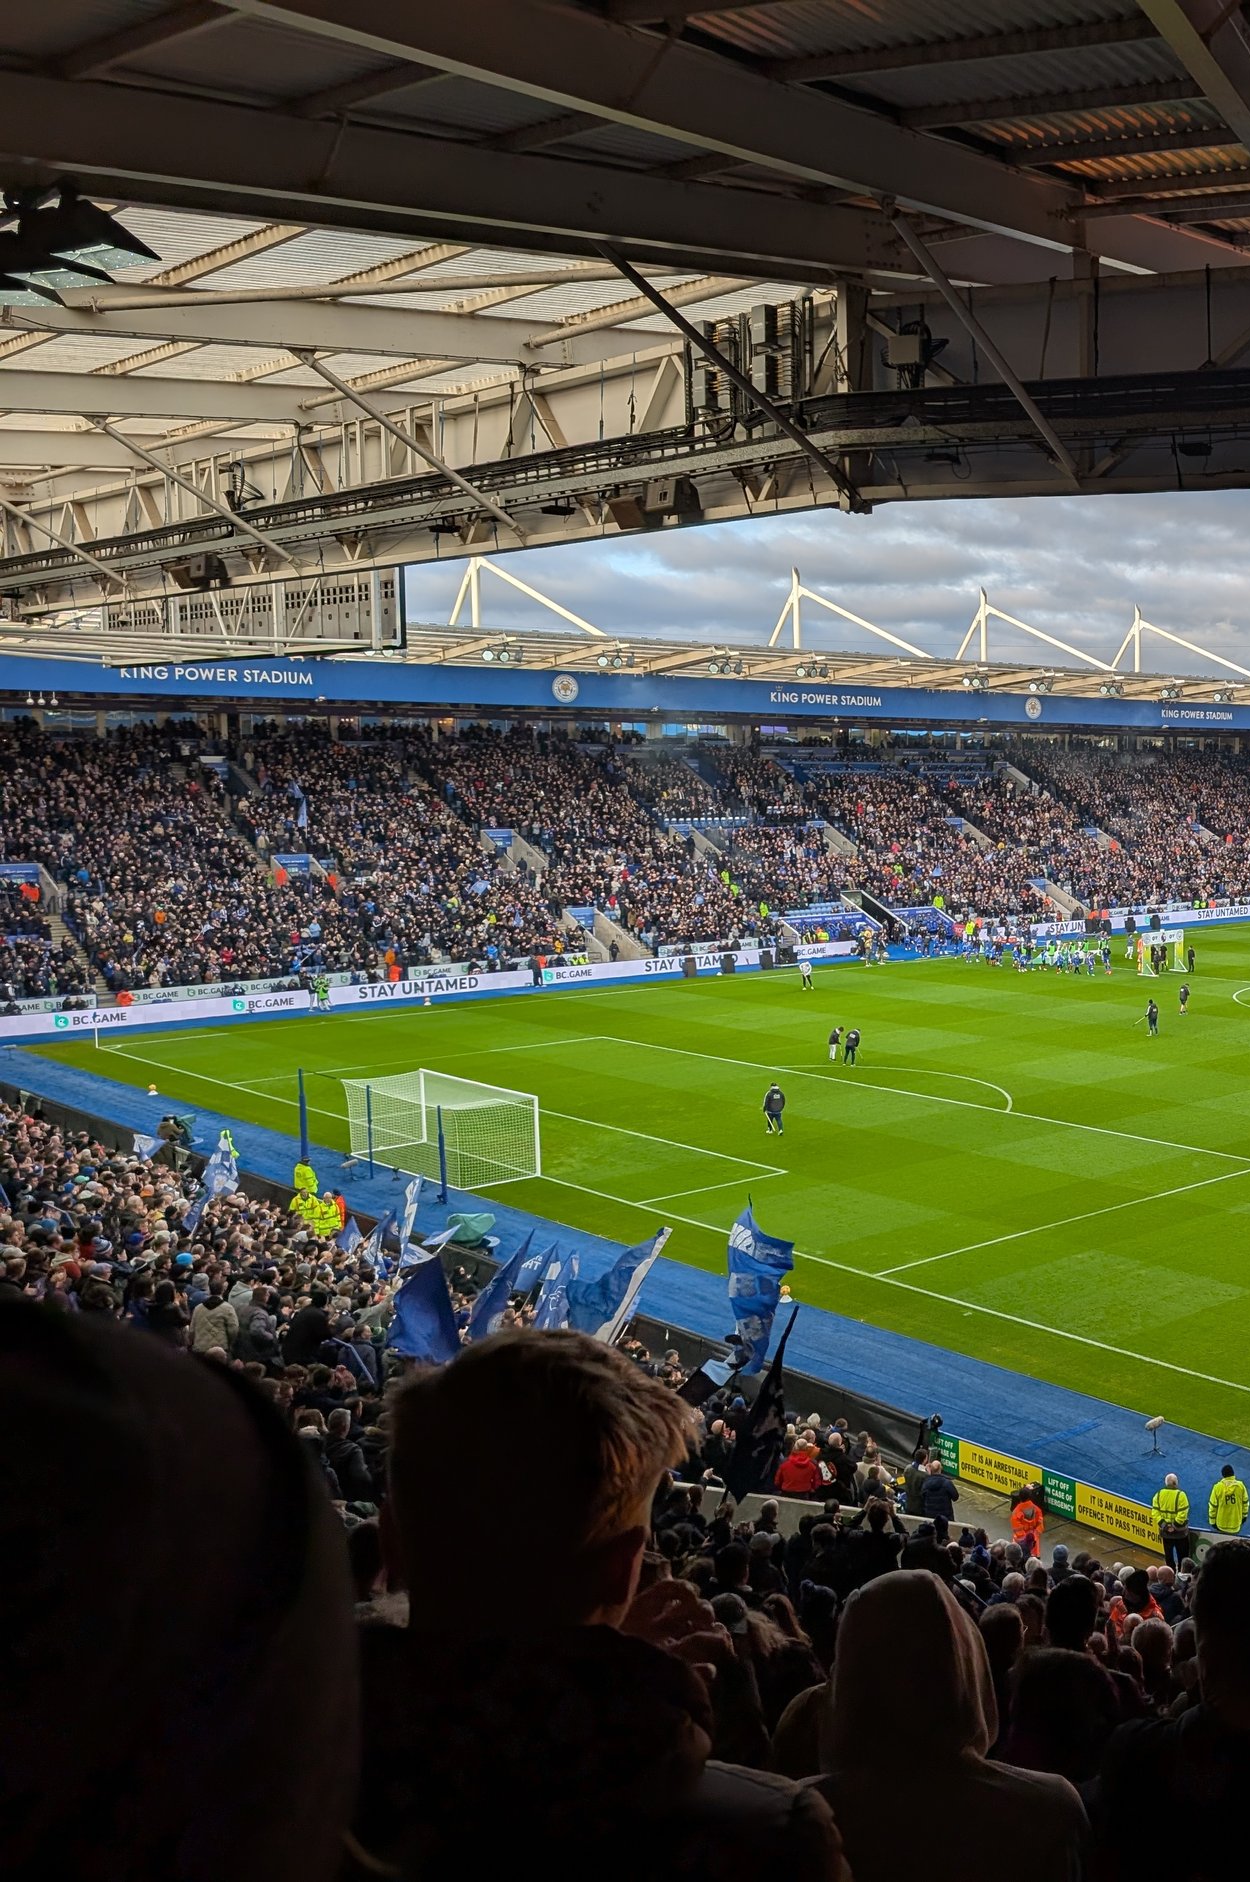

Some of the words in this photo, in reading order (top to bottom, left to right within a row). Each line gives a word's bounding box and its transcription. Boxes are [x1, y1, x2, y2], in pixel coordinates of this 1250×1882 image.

[120, 667, 168, 680] KING
[175, 668, 238, 682] POWER
[243, 670, 313, 685] STADIUM
[770, 692, 799, 702] KING
[802, 694, 838, 705] POWER
[840, 696, 882, 706] STADIUM
[1161, 710, 1180, 718] KING
[1180, 710, 1206, 720] POWER
[1206, 712, 1232, 720] STADIUM
[1198, 908, 1214, 919] STAY
[1216, 906, 1248, 918] UNTAMED
[1050, 922, 1070, 934] STAY
[644, 960, 674, 972] STAY
[556, 969, 592, 980] BC.GAME
[358, 984, 396, 999] STAY
[402, 976, 478, 994] UNTAMED
[249, 998, 294, 1009] BC.GAME
[72, 1012, 127, 1026] BC.GAME
[972, 1452, 977, 1460] IT
[978, 1455, 984, 1464] IS
[985, 1458, 993, 1468] AN
[994, 1460, 1029, 1480] ARRESTABLE
[961, 1462, 985, 1478] OFFENCE
[986, 1470, 993, 1480] TO
[994, 1474, 1008, 1486] PASS
[1048, 1477, 1059, 1488] LIFT
[1060, 1482, 1069, 1492] OFF
[1052, 1489, 1065, 1499] CASE
[1225, 1494, 1236, 1506] P6
[1090, 1495, 1096, 1504] IT
[1097, 1498, 1104, 1508] IS
[1104, 1501, 1113, 1512] AN
[1114, 1503, 1153, 1527] ARRESTABLE
[1078, 1504, 1104, 1523] OFFENCE
[1106, 1515, 1114, 1526] TO
[1115, 1518, 1130, 1533] PASS
[1132, 1524, 1146, 1539] THIS
[1147, 1530, 1162, 1544] POIN
